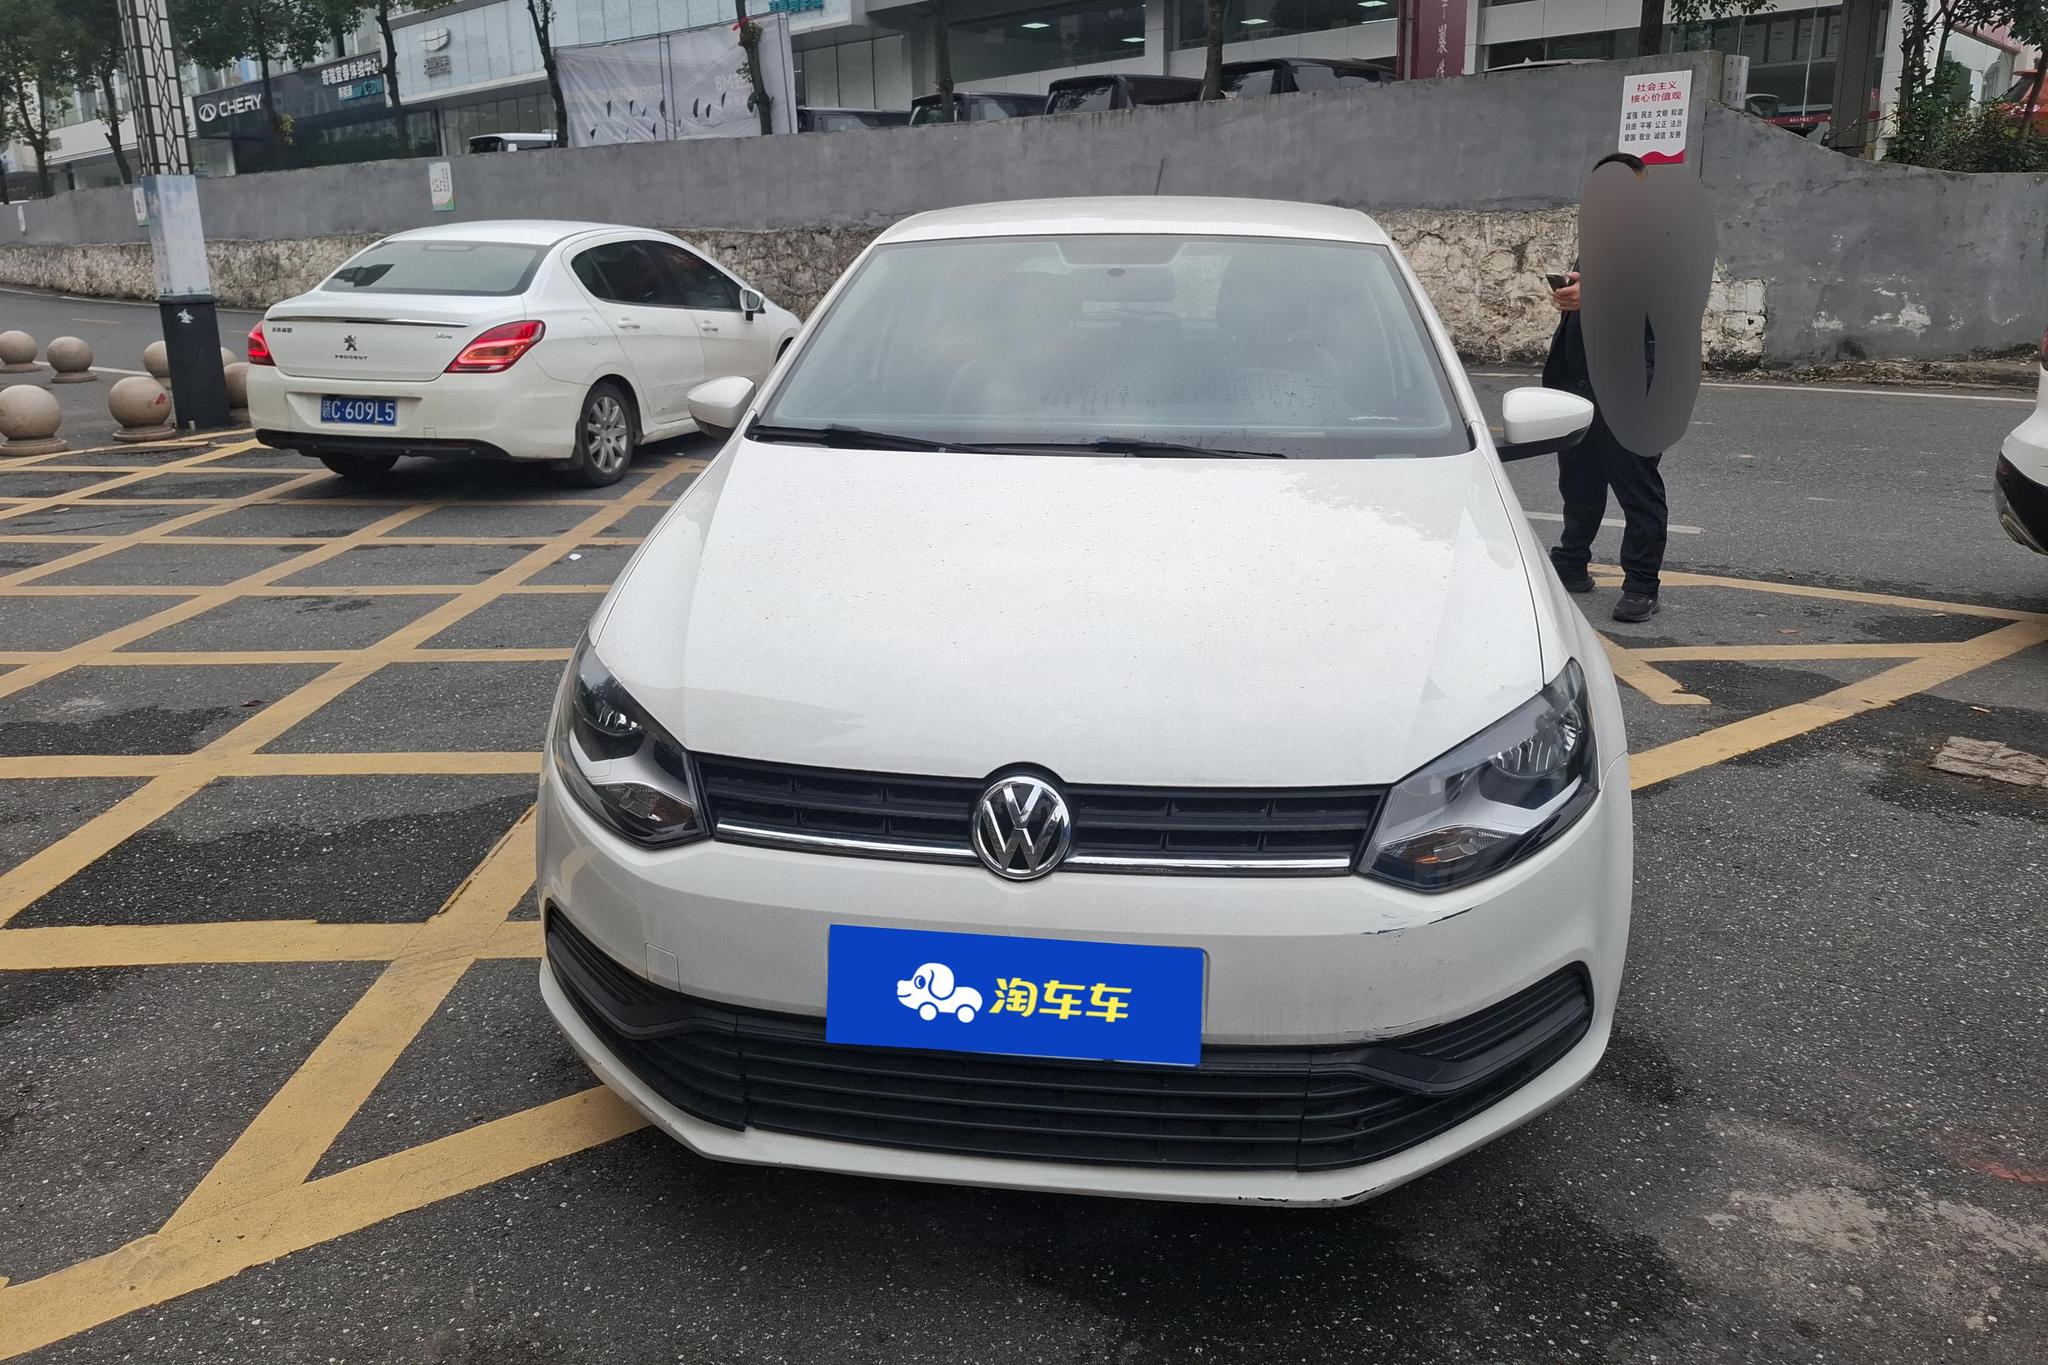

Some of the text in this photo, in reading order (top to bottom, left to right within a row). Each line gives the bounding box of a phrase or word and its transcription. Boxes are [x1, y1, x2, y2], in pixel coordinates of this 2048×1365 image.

[1637, 81, 1677, 92] 社会主义
[1631, 92, 1682, 103] 核心价值观
[218, 93, 262, 117] CHERY
